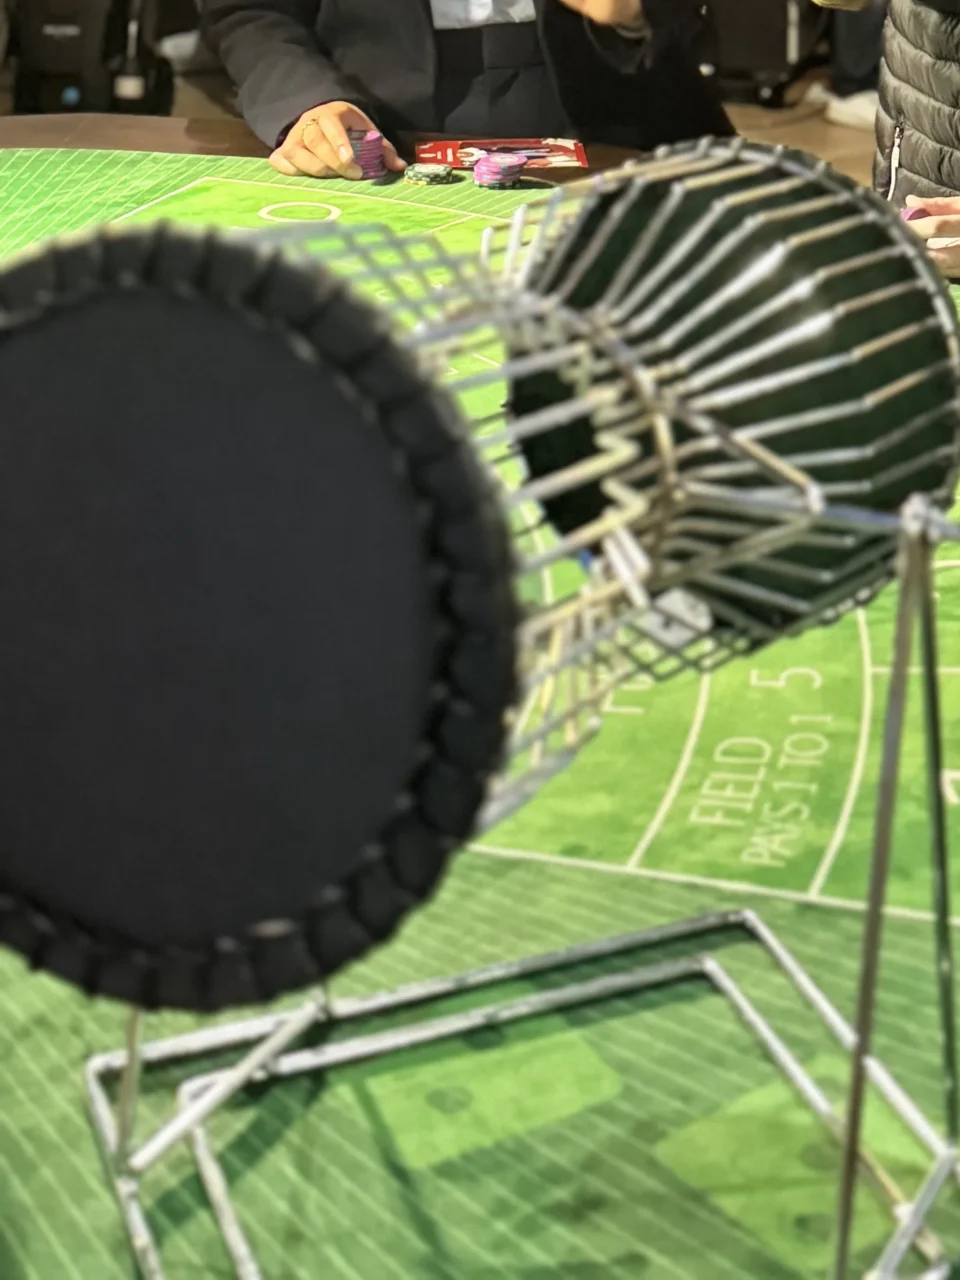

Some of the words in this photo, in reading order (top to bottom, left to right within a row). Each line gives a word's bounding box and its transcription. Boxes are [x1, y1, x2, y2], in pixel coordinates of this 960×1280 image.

[752, 666, 823, 690] 5
[789, 713, 834, 725] 1
[778, 732, 830, 770] TO
[689, 736, 772, 827] FIELD
[772, 781, 819, 794] 1
[740, 802, 811, 867] PAYS
